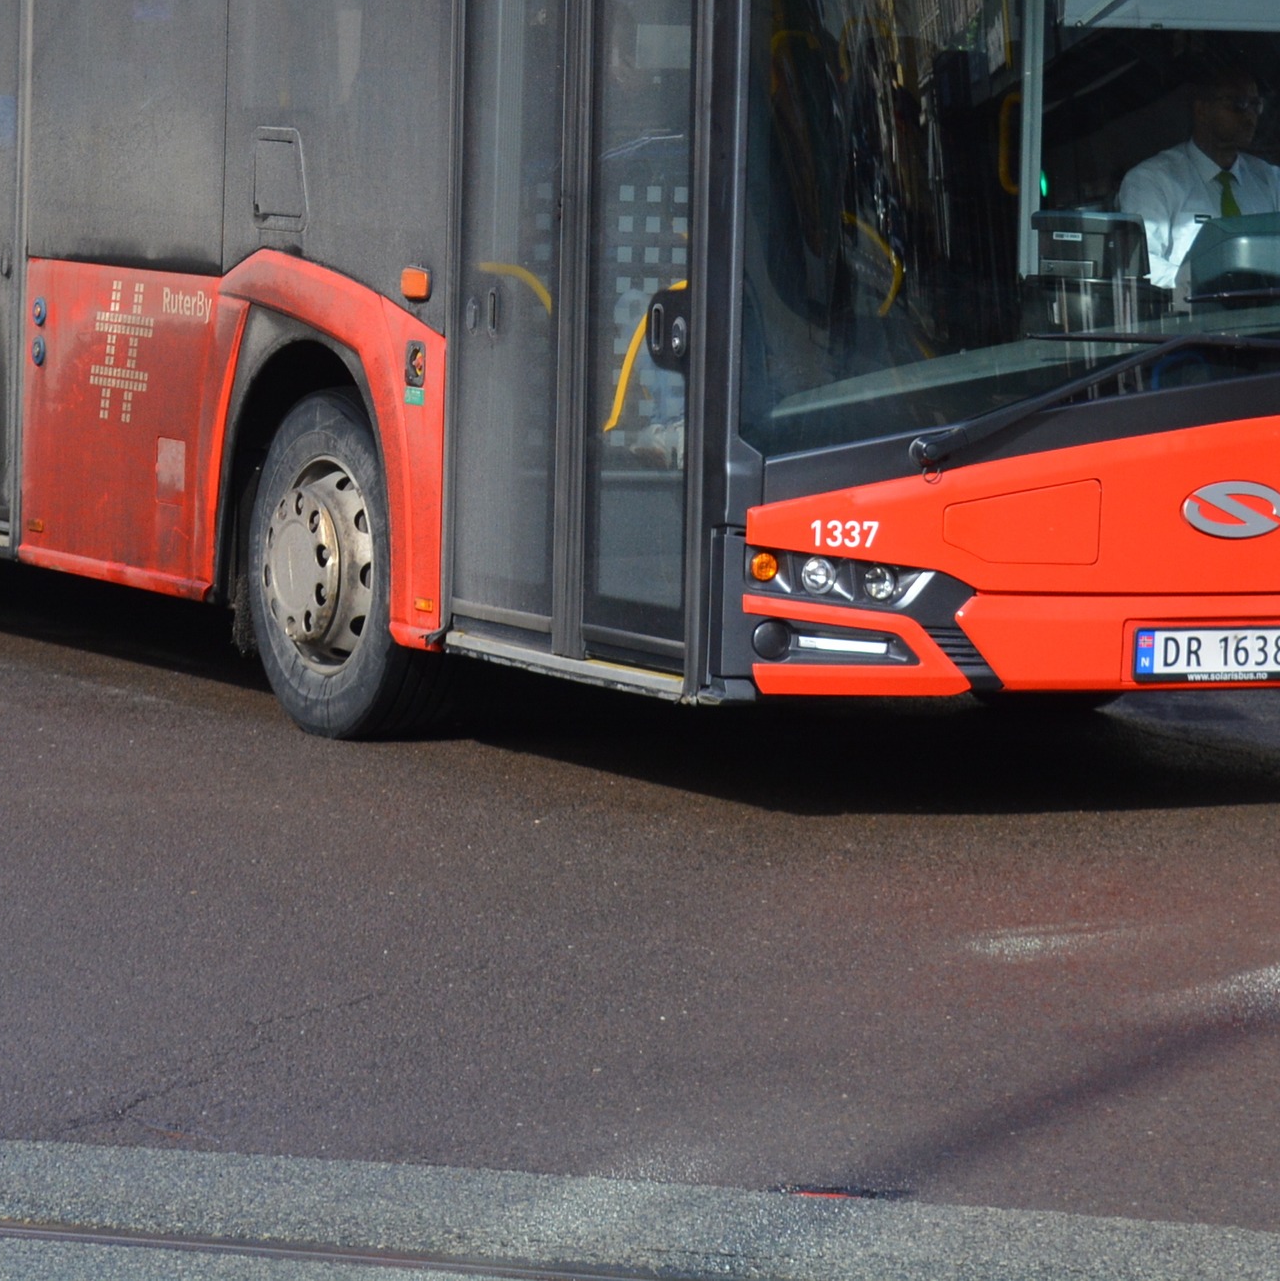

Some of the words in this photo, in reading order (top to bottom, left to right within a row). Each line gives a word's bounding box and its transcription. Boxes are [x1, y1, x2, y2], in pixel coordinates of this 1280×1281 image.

[162, 286, 212, 324] RuterBy
[810, 519, 879, 548] 1337
[1140, 657, 1150, 667] N
[1162, 636, 1202, 667] DR
[1187, 671, 1268, 682] www.solarisbus.no
